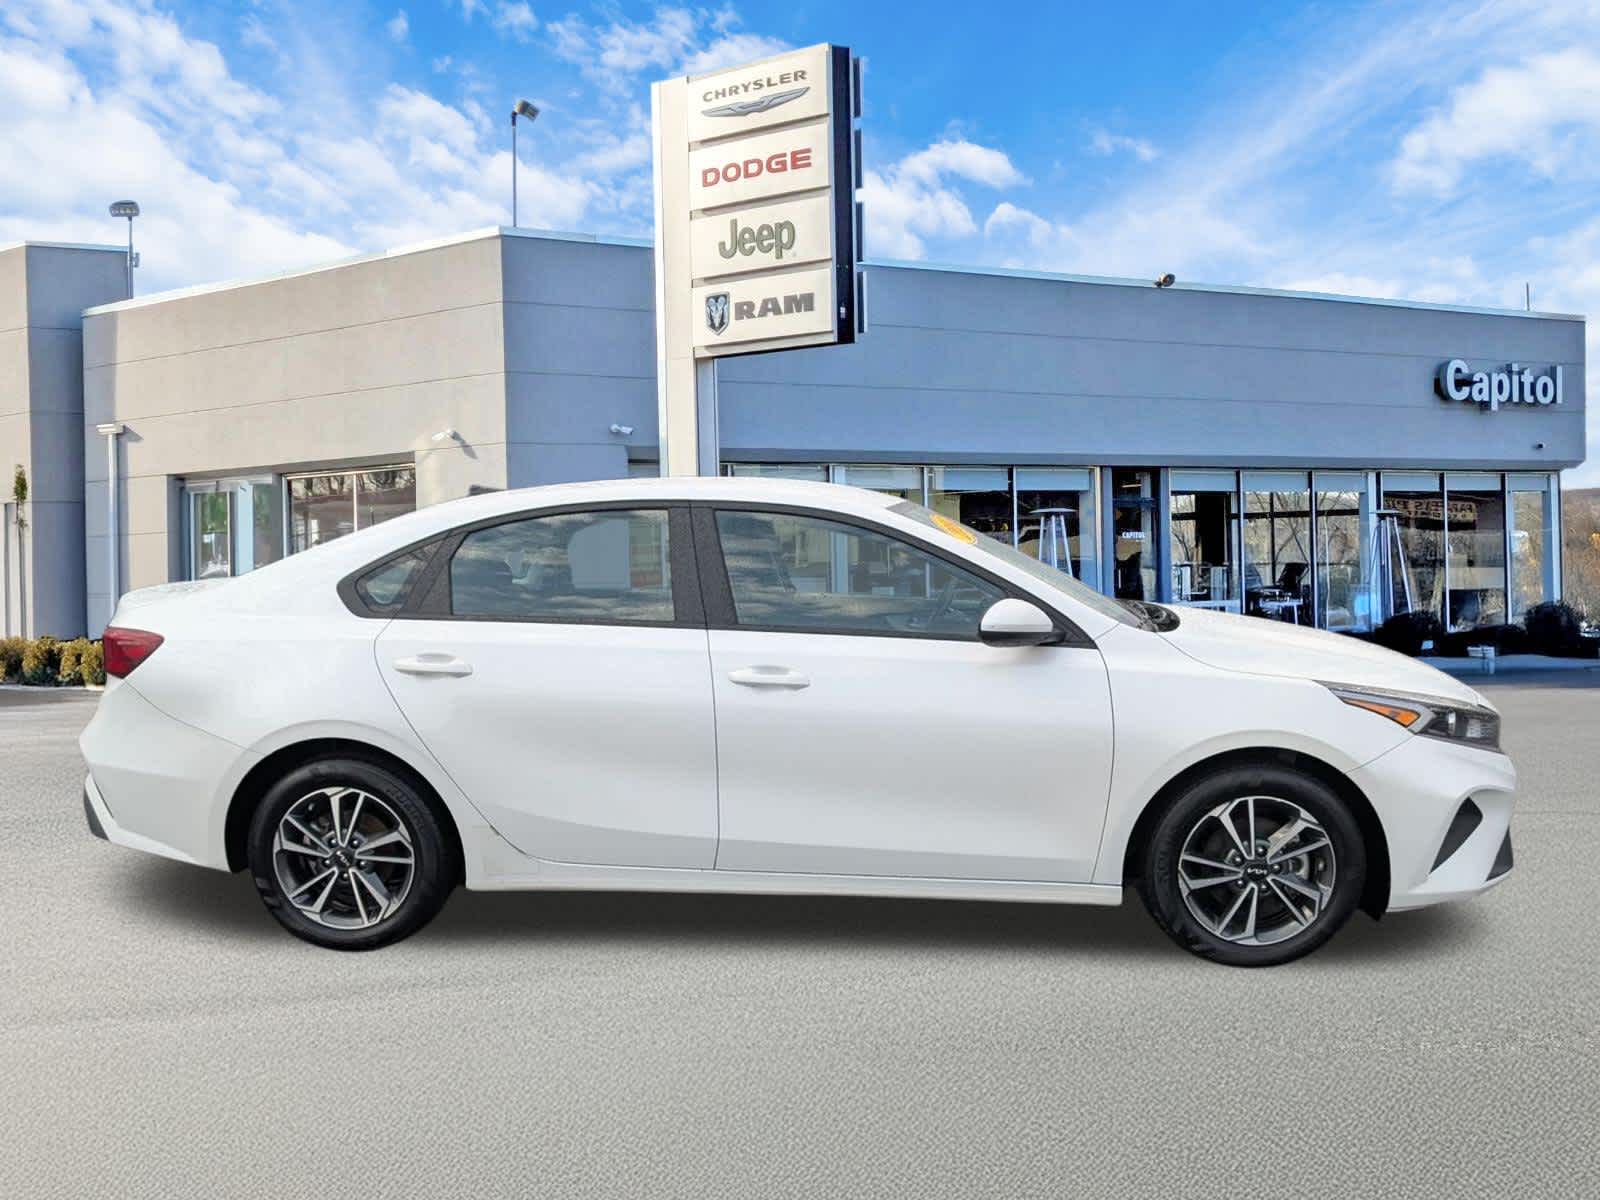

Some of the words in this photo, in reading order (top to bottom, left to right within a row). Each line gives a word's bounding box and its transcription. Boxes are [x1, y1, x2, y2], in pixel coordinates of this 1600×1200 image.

[702, 70, 807, 102] CHRYSLER
[702, 148, 812, 187] DODGE
[718, 218, 796, 259] Jeep
[734, 292, 815, 321] RAM
[1446, 358, 1563, 411] Capitol
